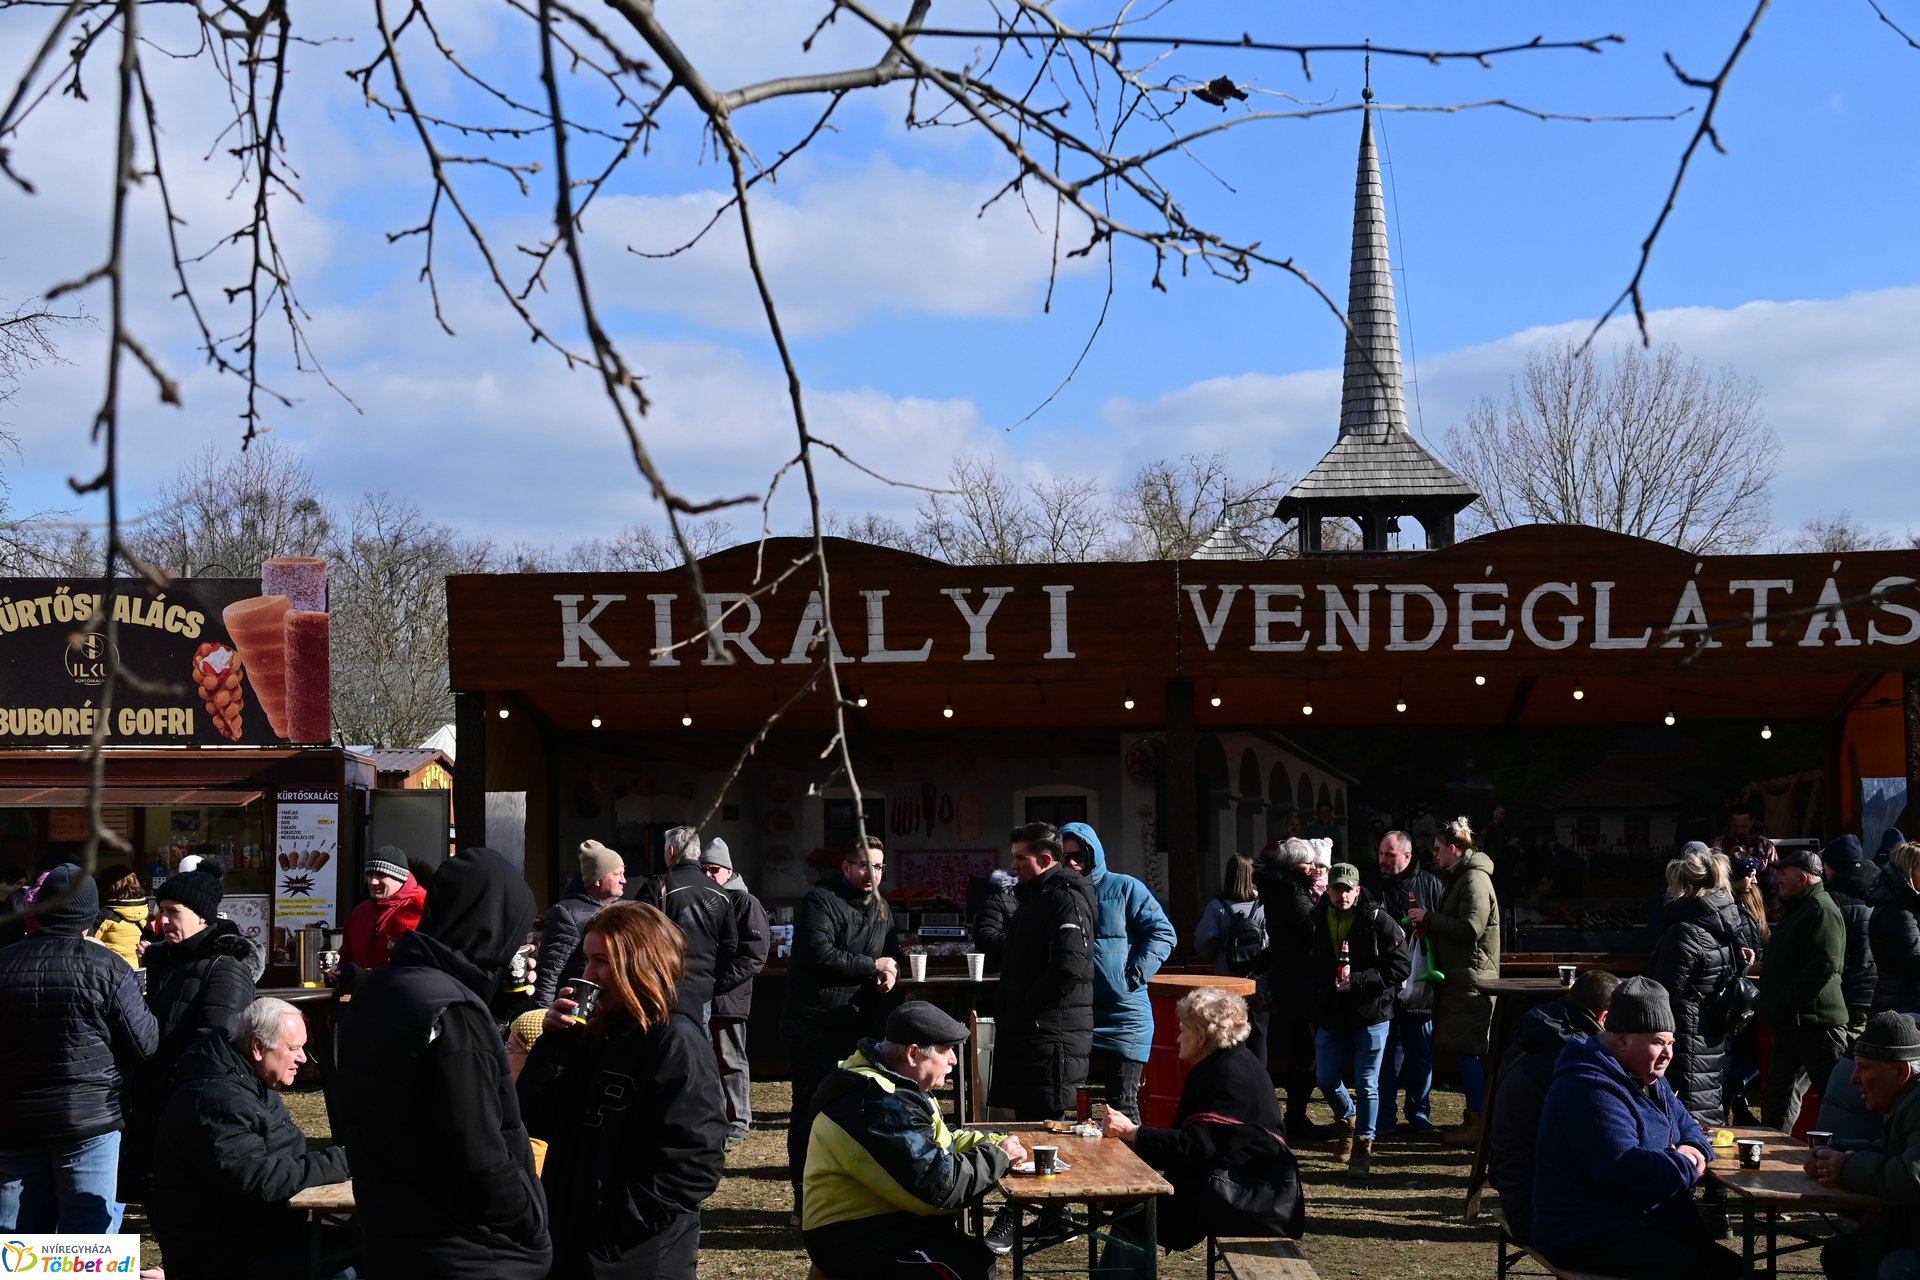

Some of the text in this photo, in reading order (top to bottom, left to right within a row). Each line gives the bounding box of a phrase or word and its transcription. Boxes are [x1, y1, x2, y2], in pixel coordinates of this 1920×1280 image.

[1182, 561, 1920, 652] VENDÉGLÁTÁS
[118, 707, 194, 736] GOFRI
[277, 790, 338, 801] KÜRTŐSKALÁCS
